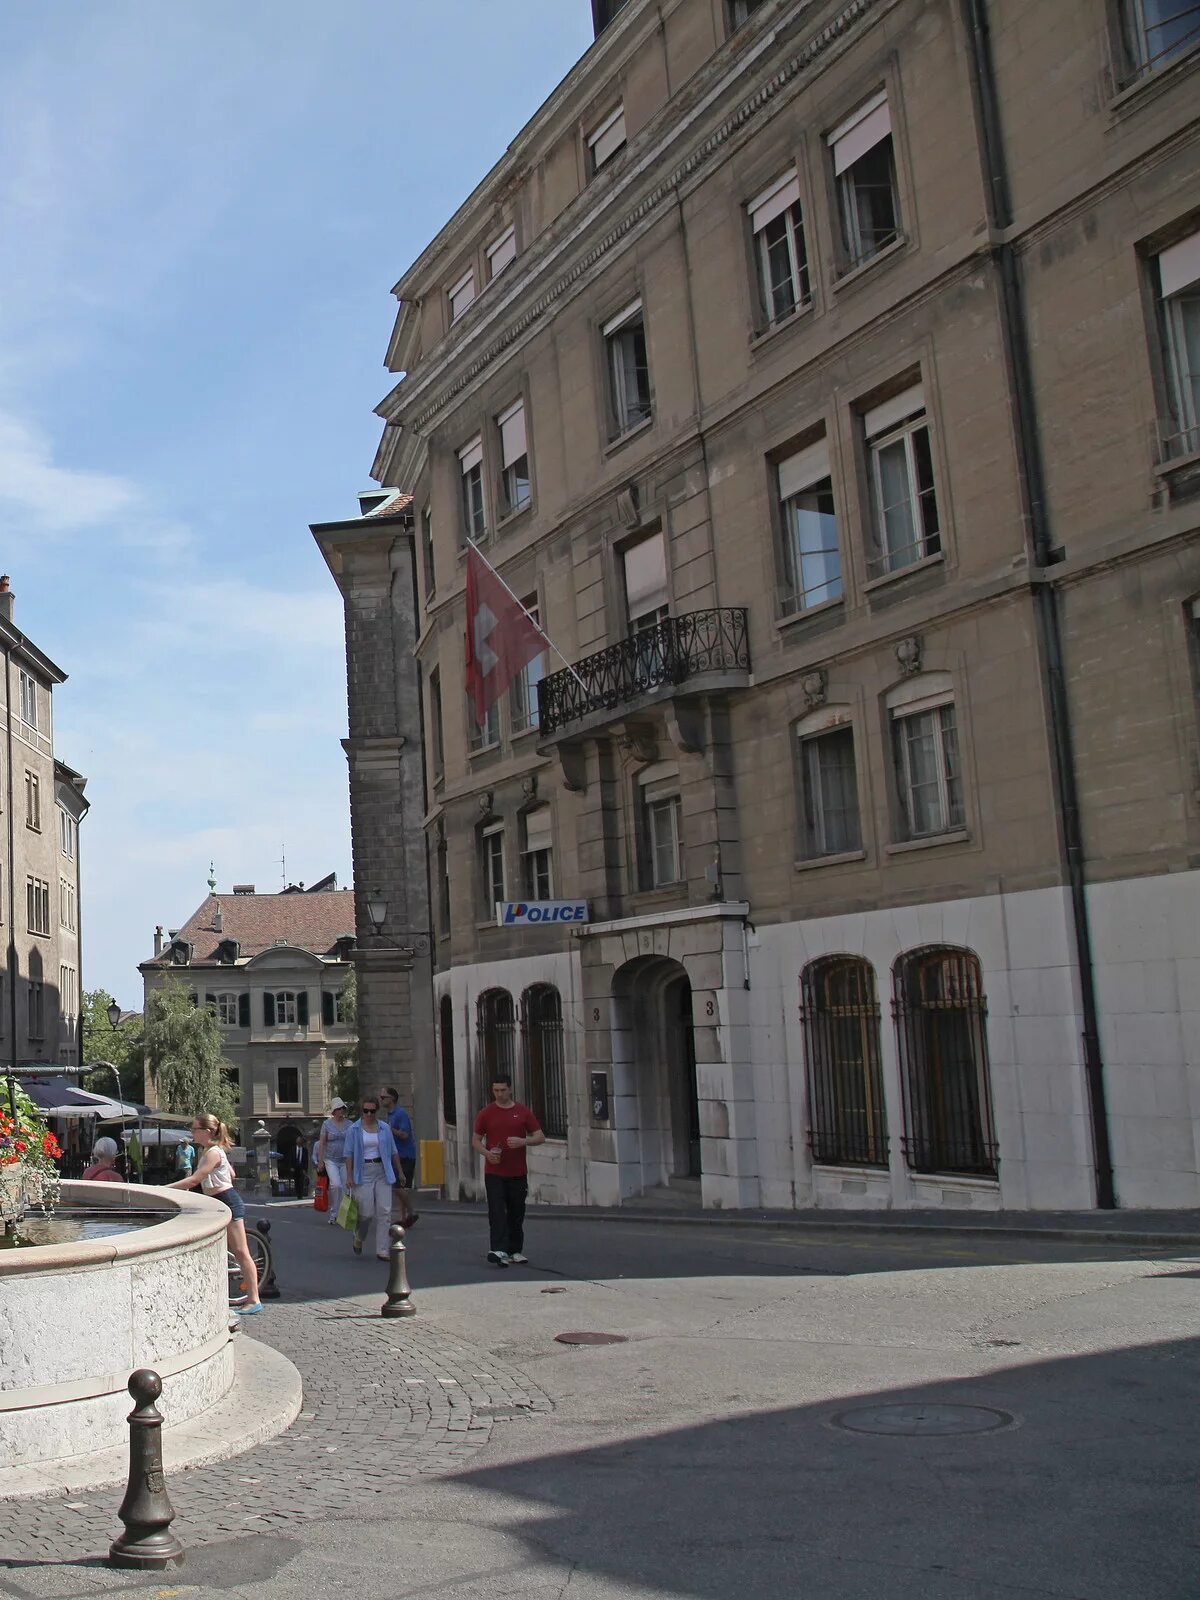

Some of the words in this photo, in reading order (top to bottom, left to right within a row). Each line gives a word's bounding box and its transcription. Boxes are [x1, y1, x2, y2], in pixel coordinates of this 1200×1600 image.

[505, 904, 585, 923] POLICE
[594, 1008, 600, 1021] 3
[707, 1001, 714, 1016] 3
